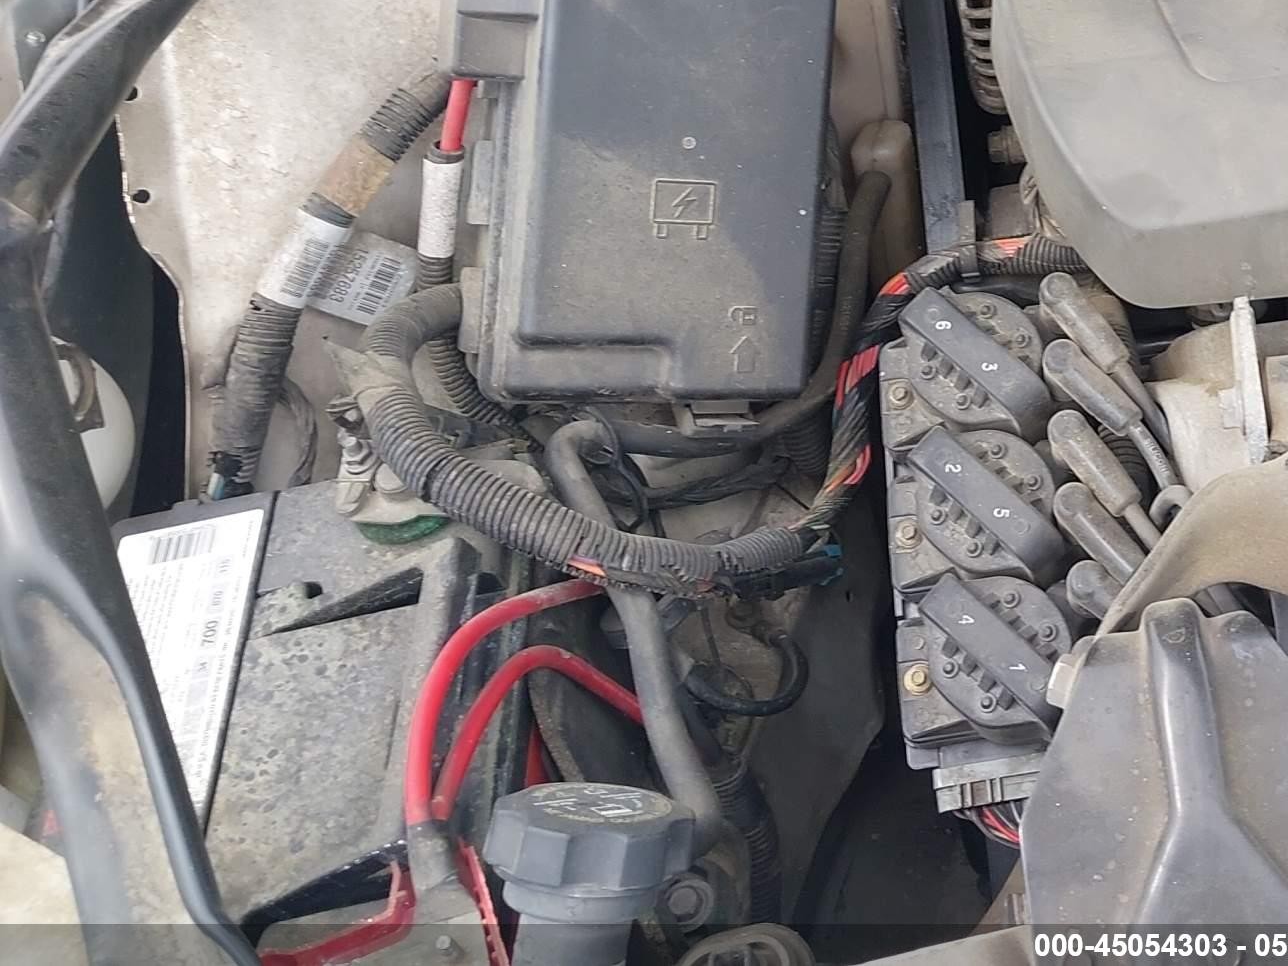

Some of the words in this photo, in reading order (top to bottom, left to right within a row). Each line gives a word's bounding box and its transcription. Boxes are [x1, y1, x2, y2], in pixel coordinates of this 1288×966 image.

[935, 320, 952, 330] 6
[981, 362, 998, 372] 3
[945, 463, 962, 473] 2
[993, 508, 1010, 518] 5
[958, 615, 975, 624] 4
[200, 620, 219, 647] 700
